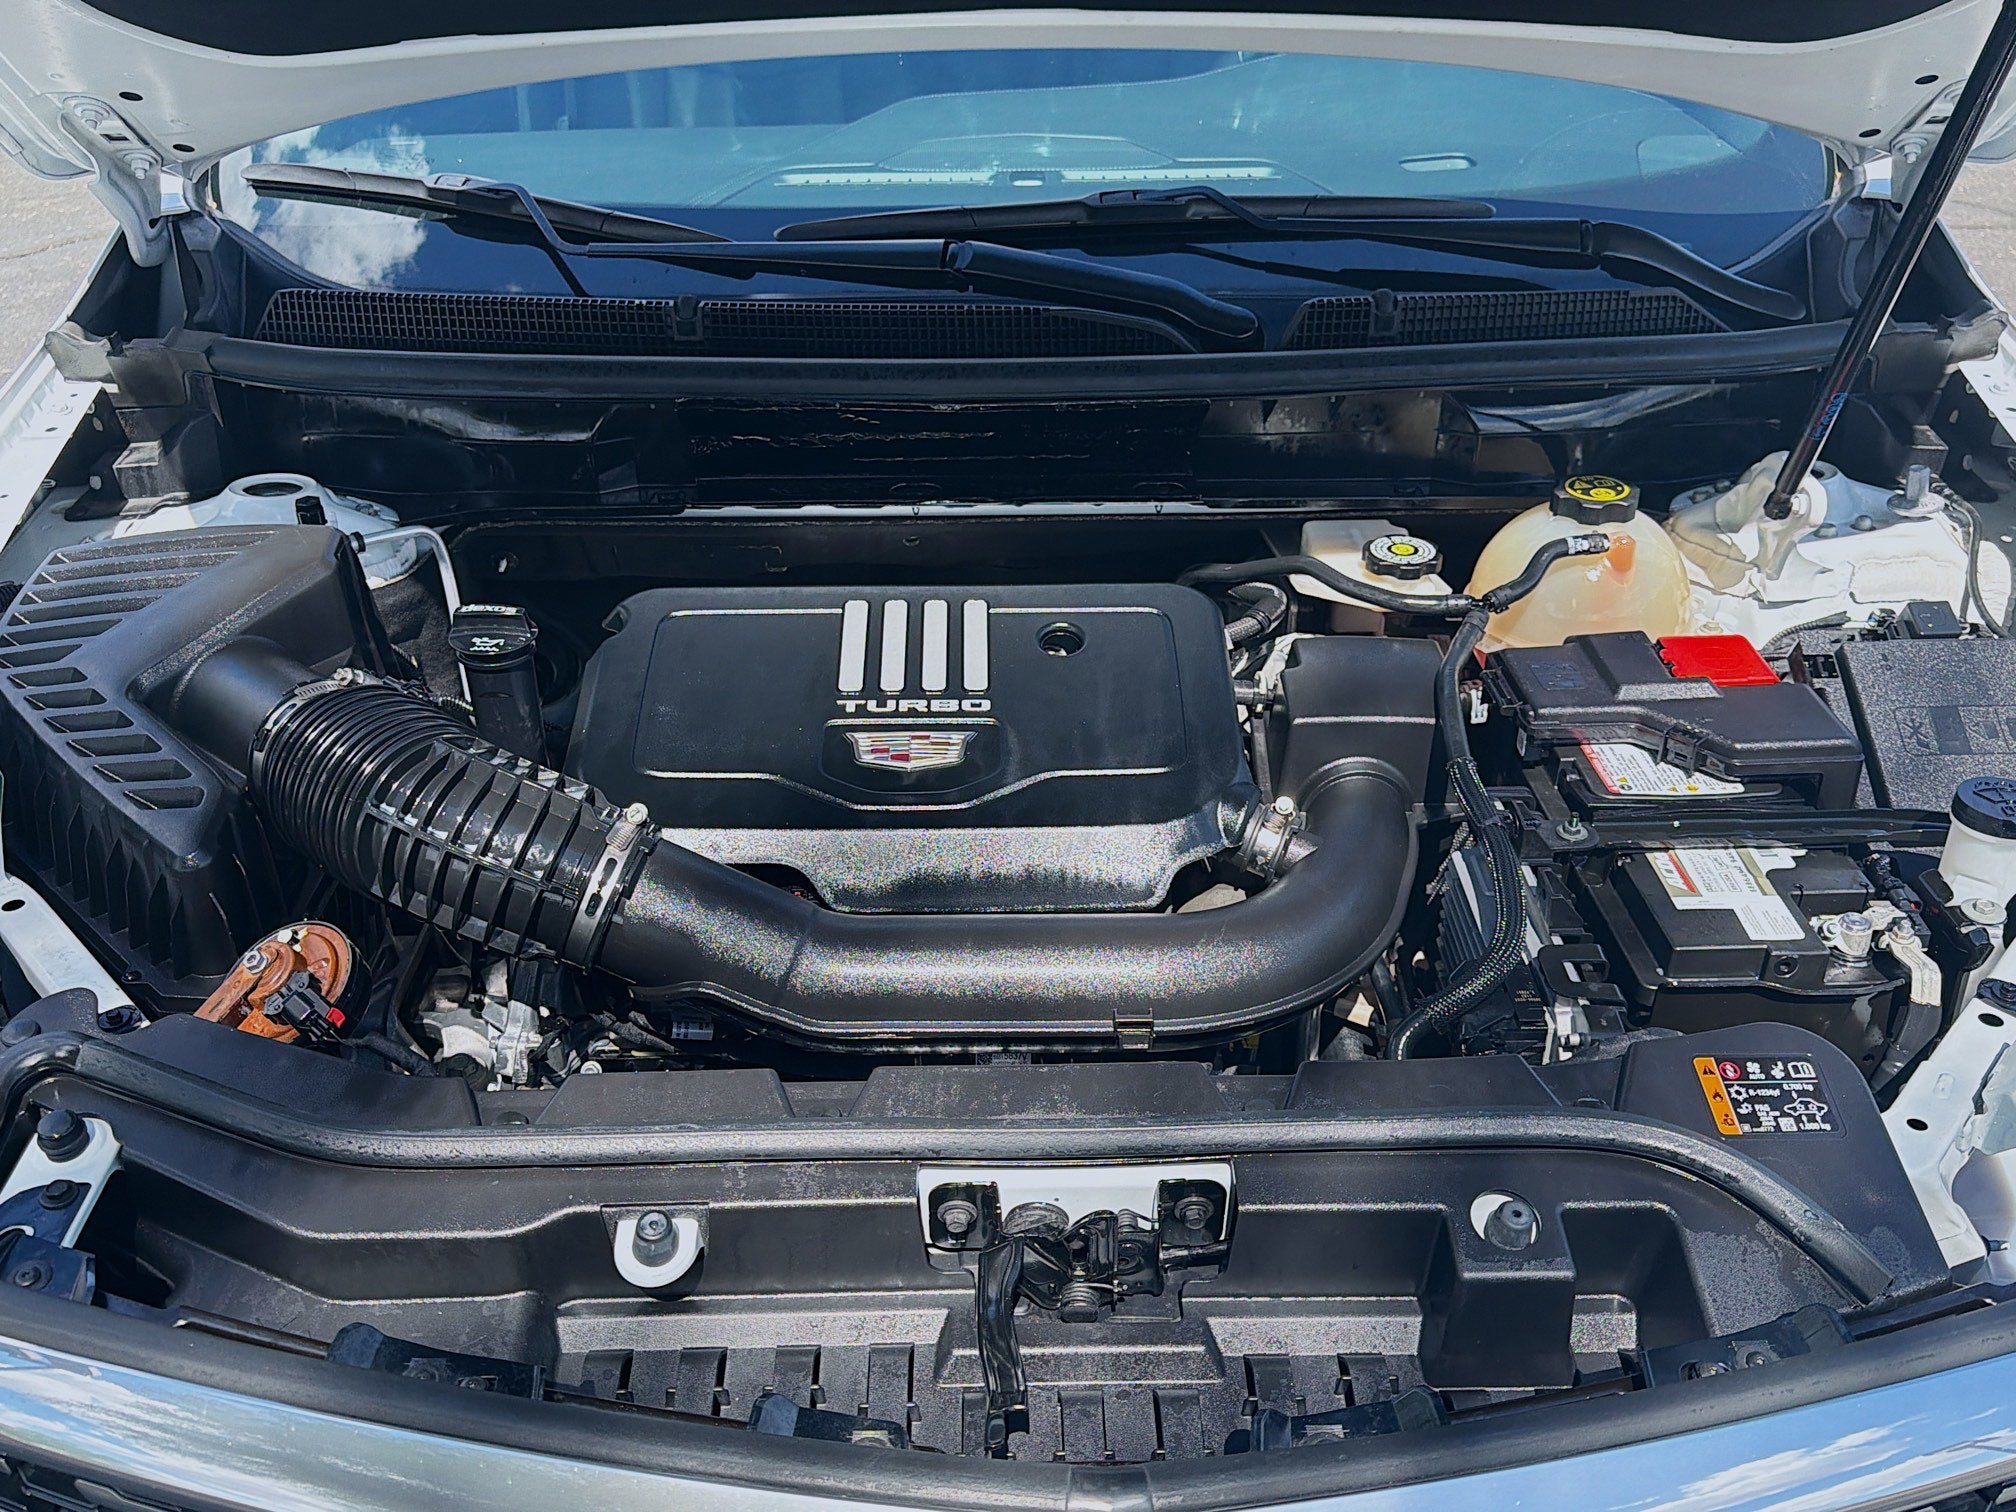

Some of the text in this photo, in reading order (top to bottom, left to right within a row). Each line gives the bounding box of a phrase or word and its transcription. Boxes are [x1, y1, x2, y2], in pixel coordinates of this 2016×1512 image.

[460, 604, 517, 614] dexos
[836, 699, 992, 713] TURBO
[1803, 1083, 1814, 1092] kg
